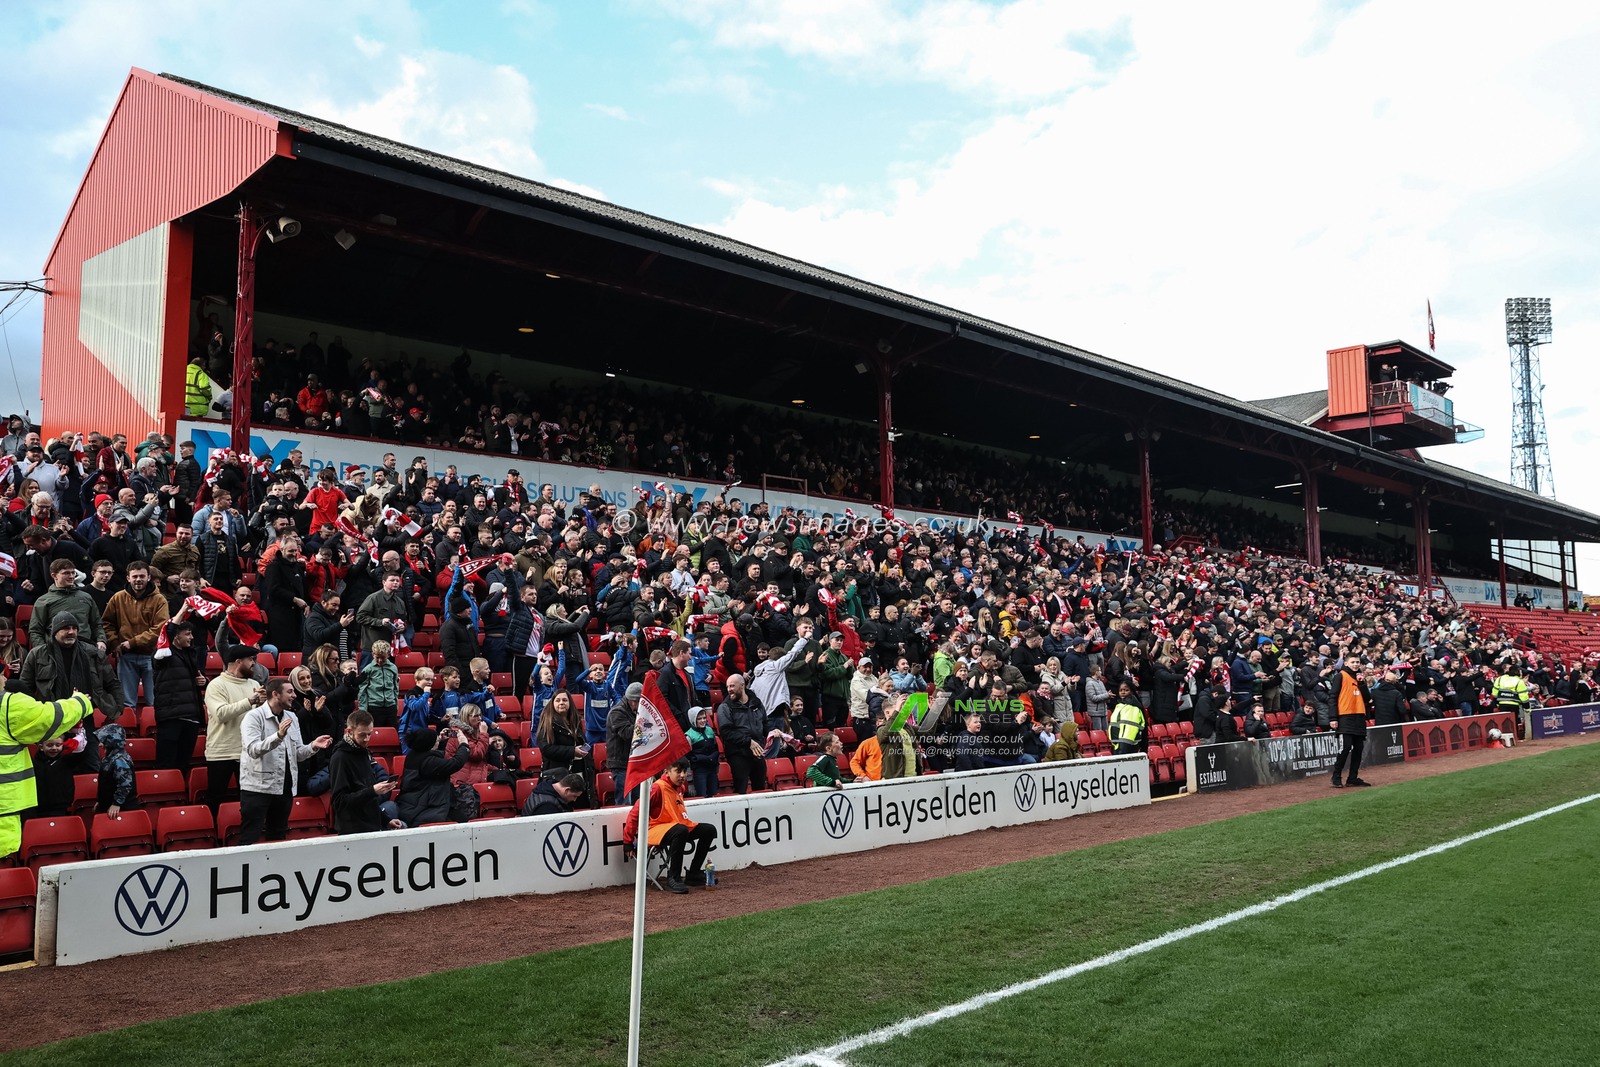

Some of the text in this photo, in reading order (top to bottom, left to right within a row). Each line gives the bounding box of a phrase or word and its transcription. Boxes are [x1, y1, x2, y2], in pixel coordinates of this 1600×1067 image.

[309, 459, 383, 483] PARC
[527, 482, 627, 508] SLUTNS
[1484, 583, 1497, 601] DX
[640, 699, 667, 738] BARNSLEY FC
[1268, 740, 1287, 762] 10%
[1286, 738, 1301, 760] OFF
[1302, 737, 1314, 758] ON
[1042, 768, 1140, 809] Hayselden
[864, 784, 996, 834] Hayselden
[210, 842, 499, 921] Hayselden
